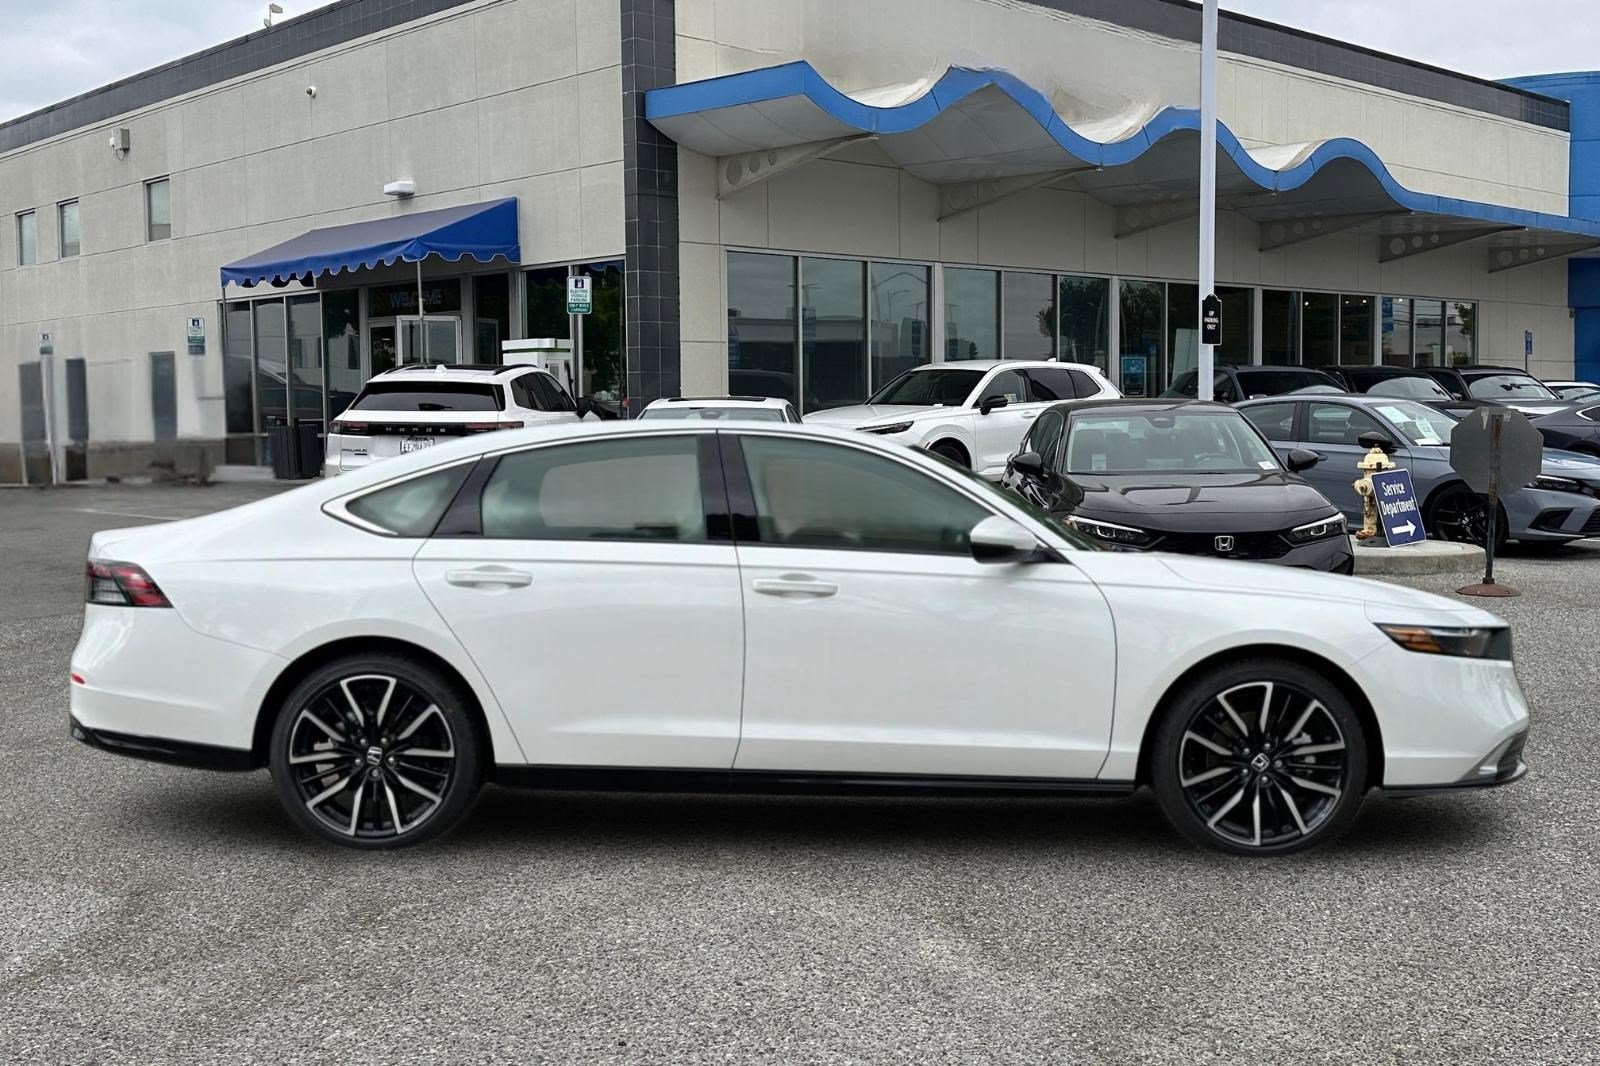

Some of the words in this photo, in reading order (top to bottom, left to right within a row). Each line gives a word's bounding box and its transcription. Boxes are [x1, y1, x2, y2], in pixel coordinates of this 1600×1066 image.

[391, 288, 441, 307] WELCME
[1381, 480, 1406, 496] Service
[1380, 496, 1417, 518] Department
